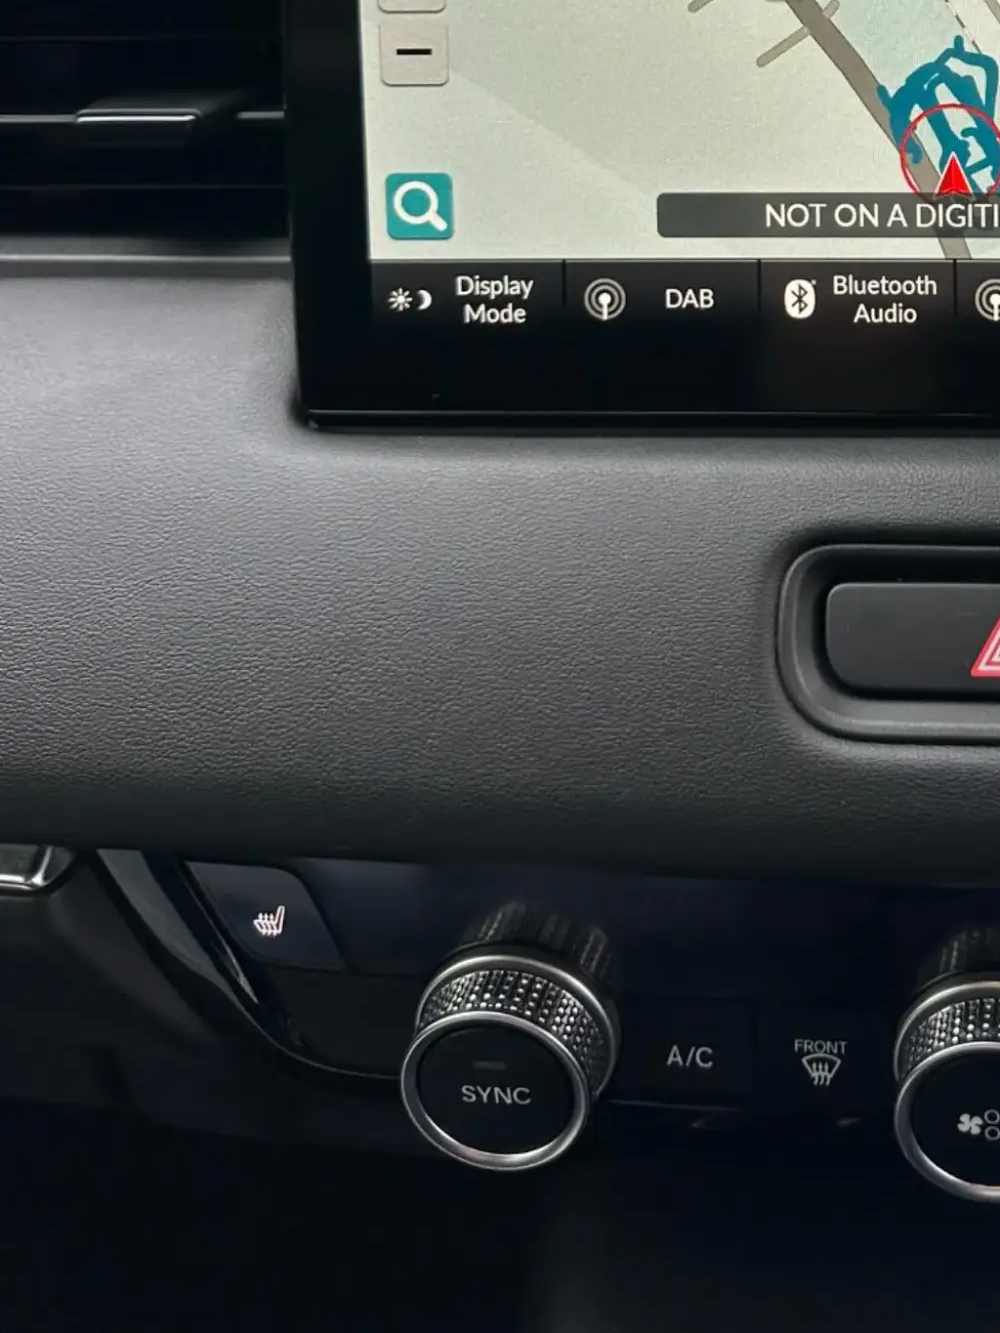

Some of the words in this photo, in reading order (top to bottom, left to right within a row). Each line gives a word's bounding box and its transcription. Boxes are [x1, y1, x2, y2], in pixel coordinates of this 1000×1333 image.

[765, 203, 827, 228] NOT
[834, 203, 879, 228] ON
[886, 203, 908, 228] A
[455, 274, 534, 300] Display
[833, 274, 938, 296] Bluetooth
[665, 288, 714, 309] DAB
[464, 302, 527, 324] Mode
[853, 302, 918, 324] Audio
[666, 1044, 713, 1069] A/C
[794, 1038, 847, 1055] FRONT
[461, 1084, 531, 1105] SYNC
